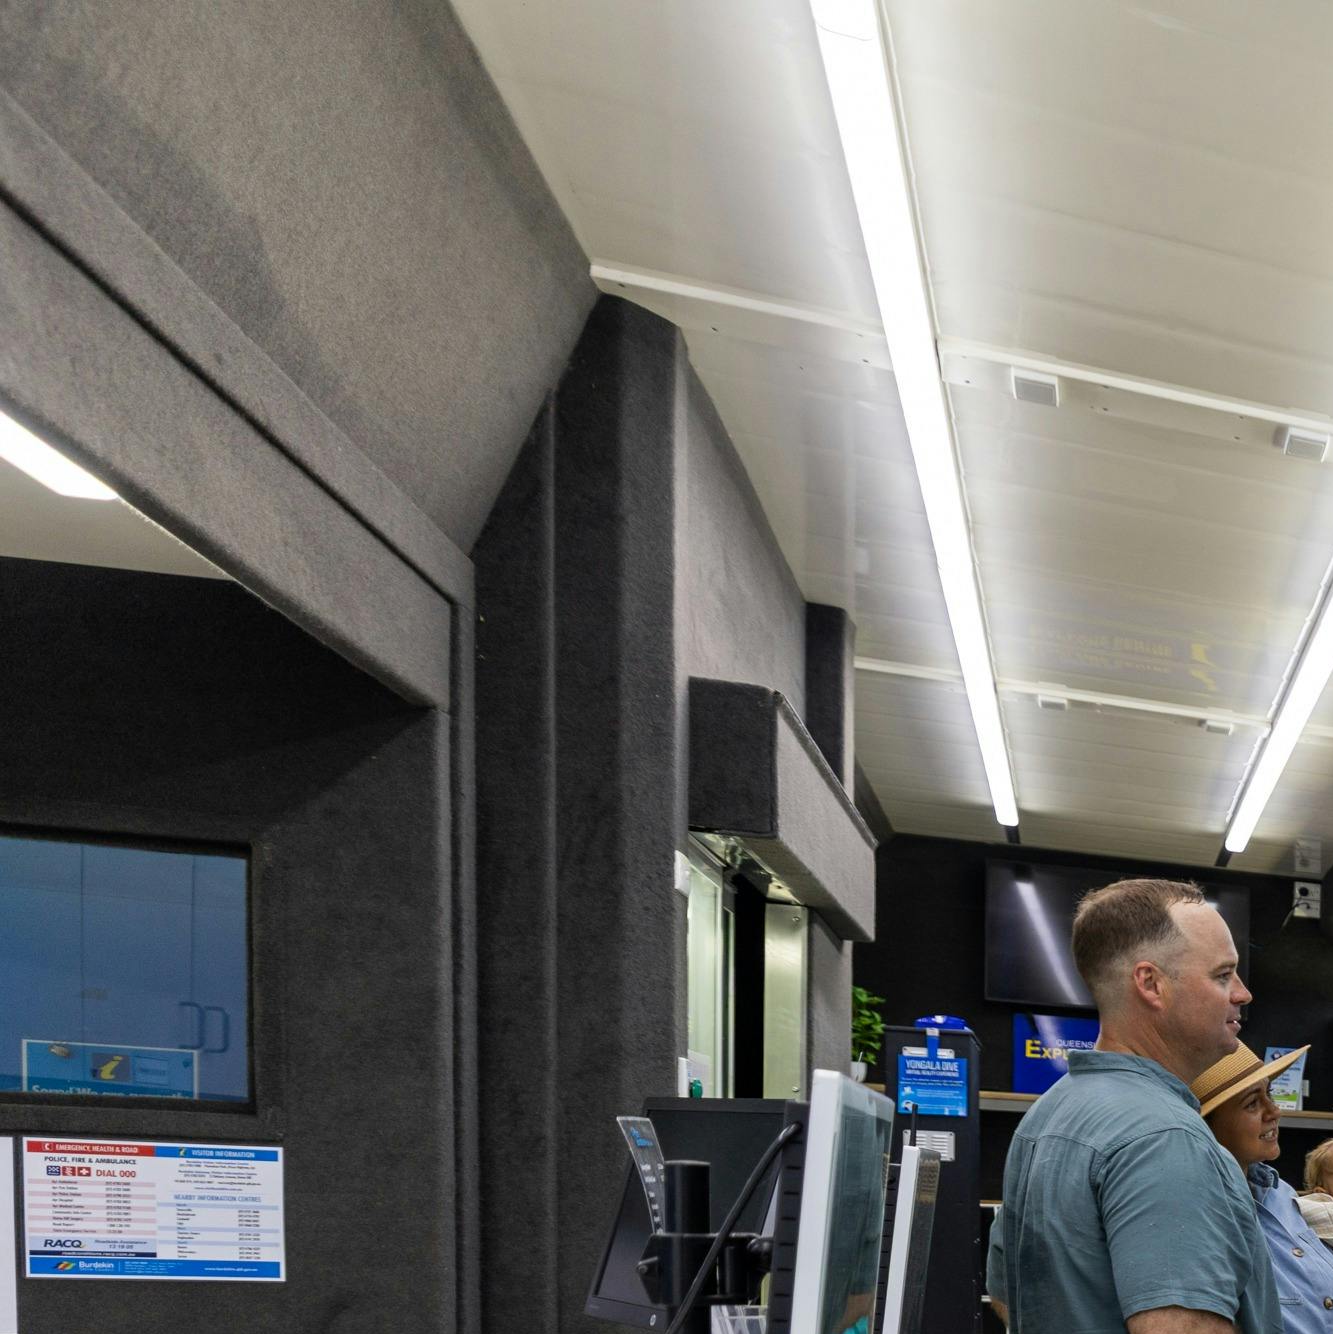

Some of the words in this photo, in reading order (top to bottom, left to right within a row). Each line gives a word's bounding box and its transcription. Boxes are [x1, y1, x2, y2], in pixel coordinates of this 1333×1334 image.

[906, 1059, 940, 1072] YONGALA
[941, 1062, 959, 1072] DIVE
[95, 1157, 136, 1165] AMBULANCE
[96, 1169, 117, 1177] DIAL
[119, 1170, 136, 1178] 000
[43, 1239, 83, 1248] RACQ
[79, 1261, 114, 1269] Burdekin
